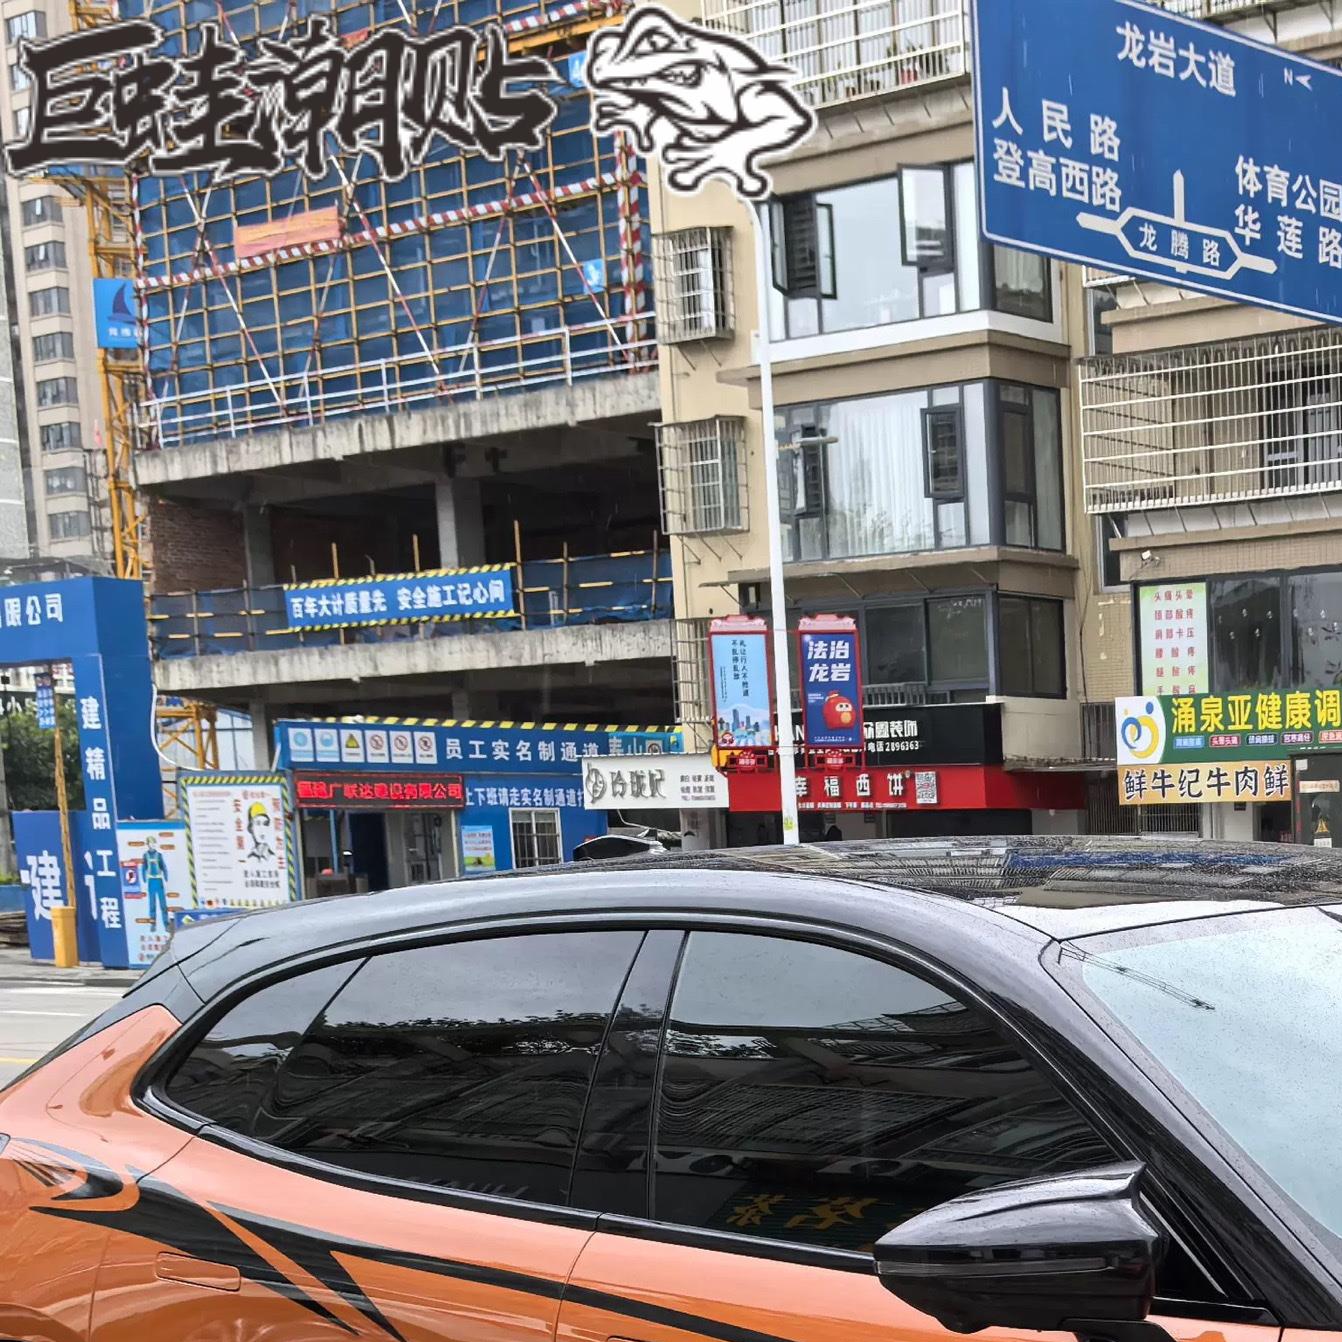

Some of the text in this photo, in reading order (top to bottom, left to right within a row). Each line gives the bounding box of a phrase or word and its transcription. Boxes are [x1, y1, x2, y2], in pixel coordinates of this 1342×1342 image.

[1116, 22, 1236, 97] 龙岩大道
[1284, 68, 1294, 86] N
[992, 87, 1121, 162] 人民路
[993, 138, 1122, 212] 登高西路
[1138, 222, 1221, 268] 龙腾路
[0, 593, 63, 629] 限公司
[807, 640, 850, 660] 法治
[809, 662, 851, 683] 龙岩
[445, 738, 600, 763] 员工实名制通道
[796, 773, 904, 798] 幸福西饼
[1124, 764, 1290, 801] 鲜牛纪牛肉鲜
[80, 696, 123, 929] 建精品工程
